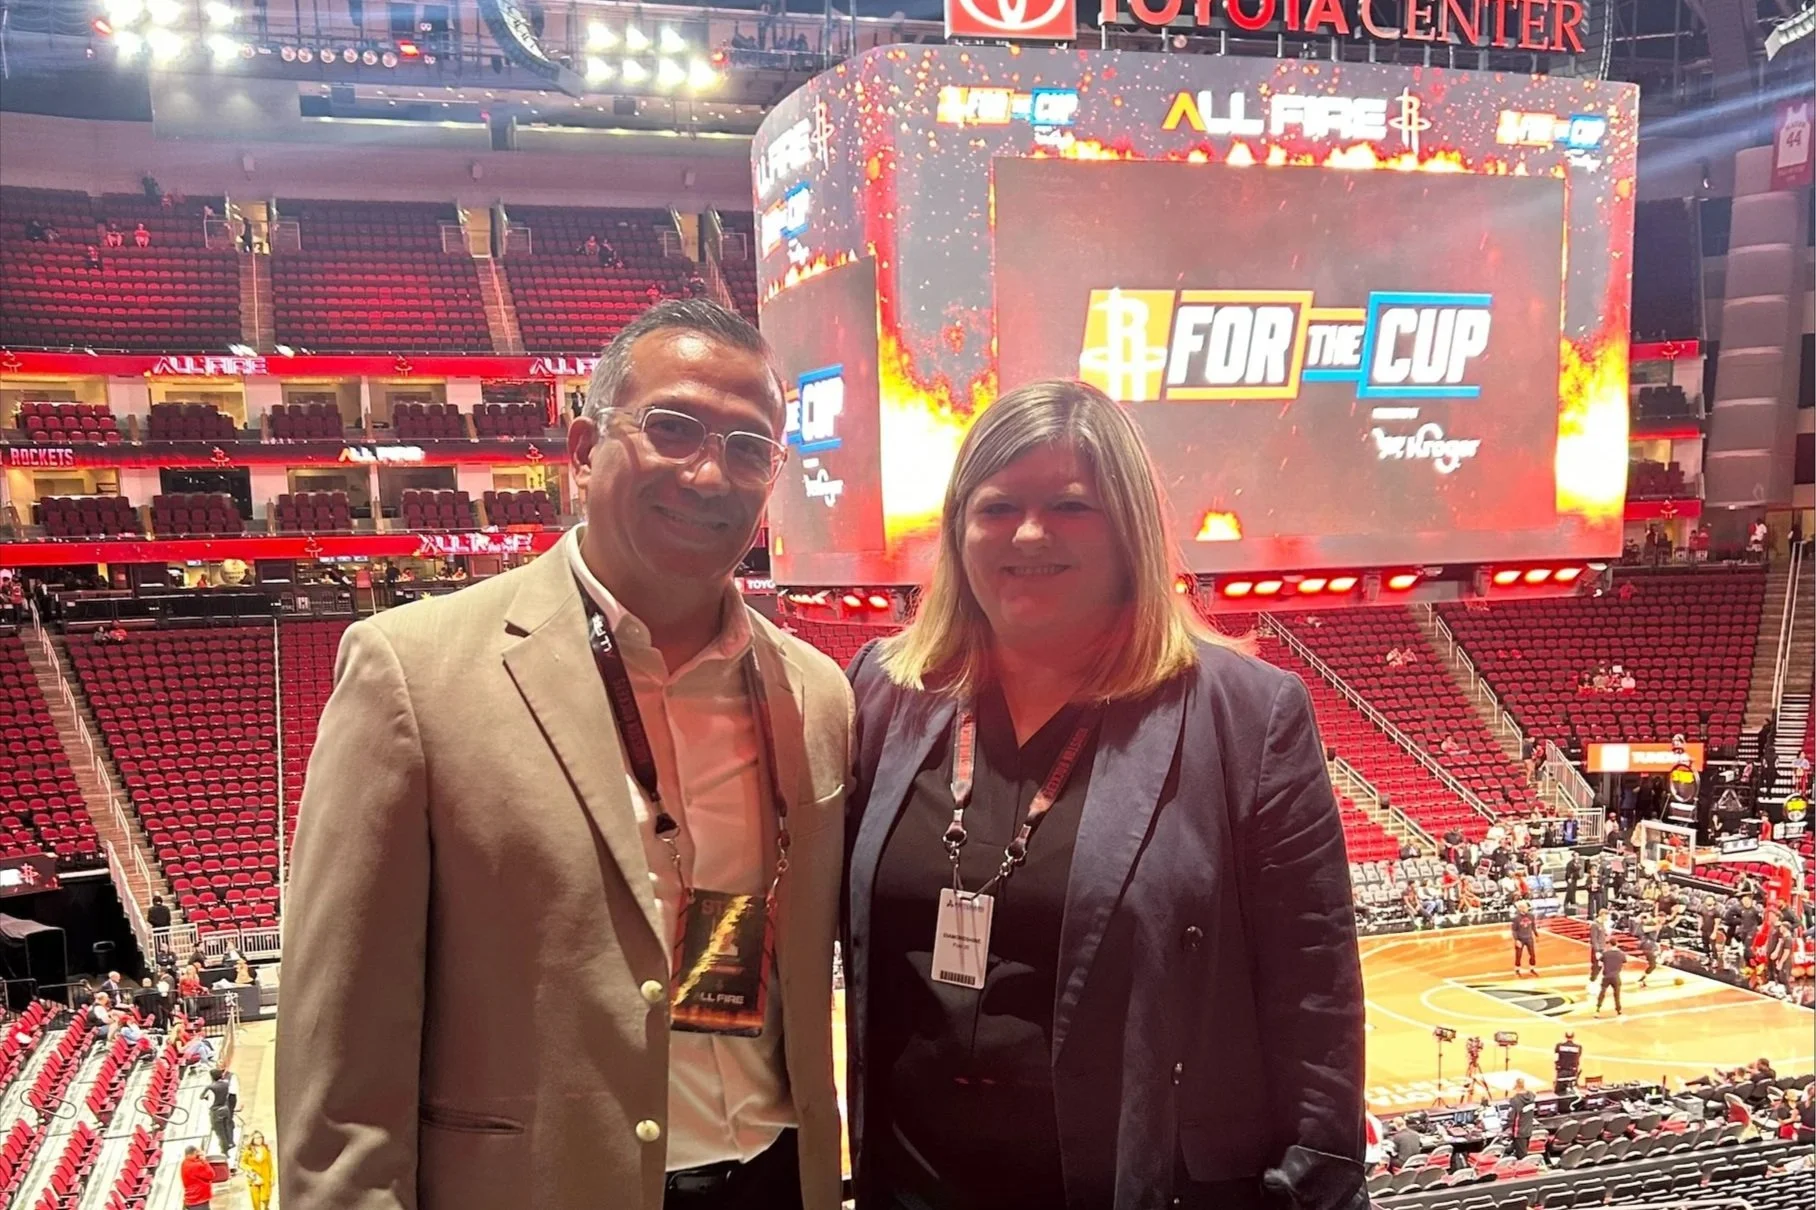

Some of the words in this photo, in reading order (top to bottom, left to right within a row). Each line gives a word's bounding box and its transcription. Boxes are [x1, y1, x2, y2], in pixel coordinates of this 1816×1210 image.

[1359, 0, 1586, 53] CENTER
[1161, 90, 1265, 135] ALL
[1270, 94, 1388, 139] FIRE
[1786, 130, 1802, 147] 44
[1166, 305, 1295, 385] FOR
[1308, 324, 1365, 367] THE
[1373, 307, 1492, 384] CUP
[152, 356, 206, 375] ALL
[529, 356, 577, 376] ALL
[10, 447, 74, 467] ROCKETS
[1405, 422, 1481, 474] Kroger
[716, 993, 745, 1005] FIRE
